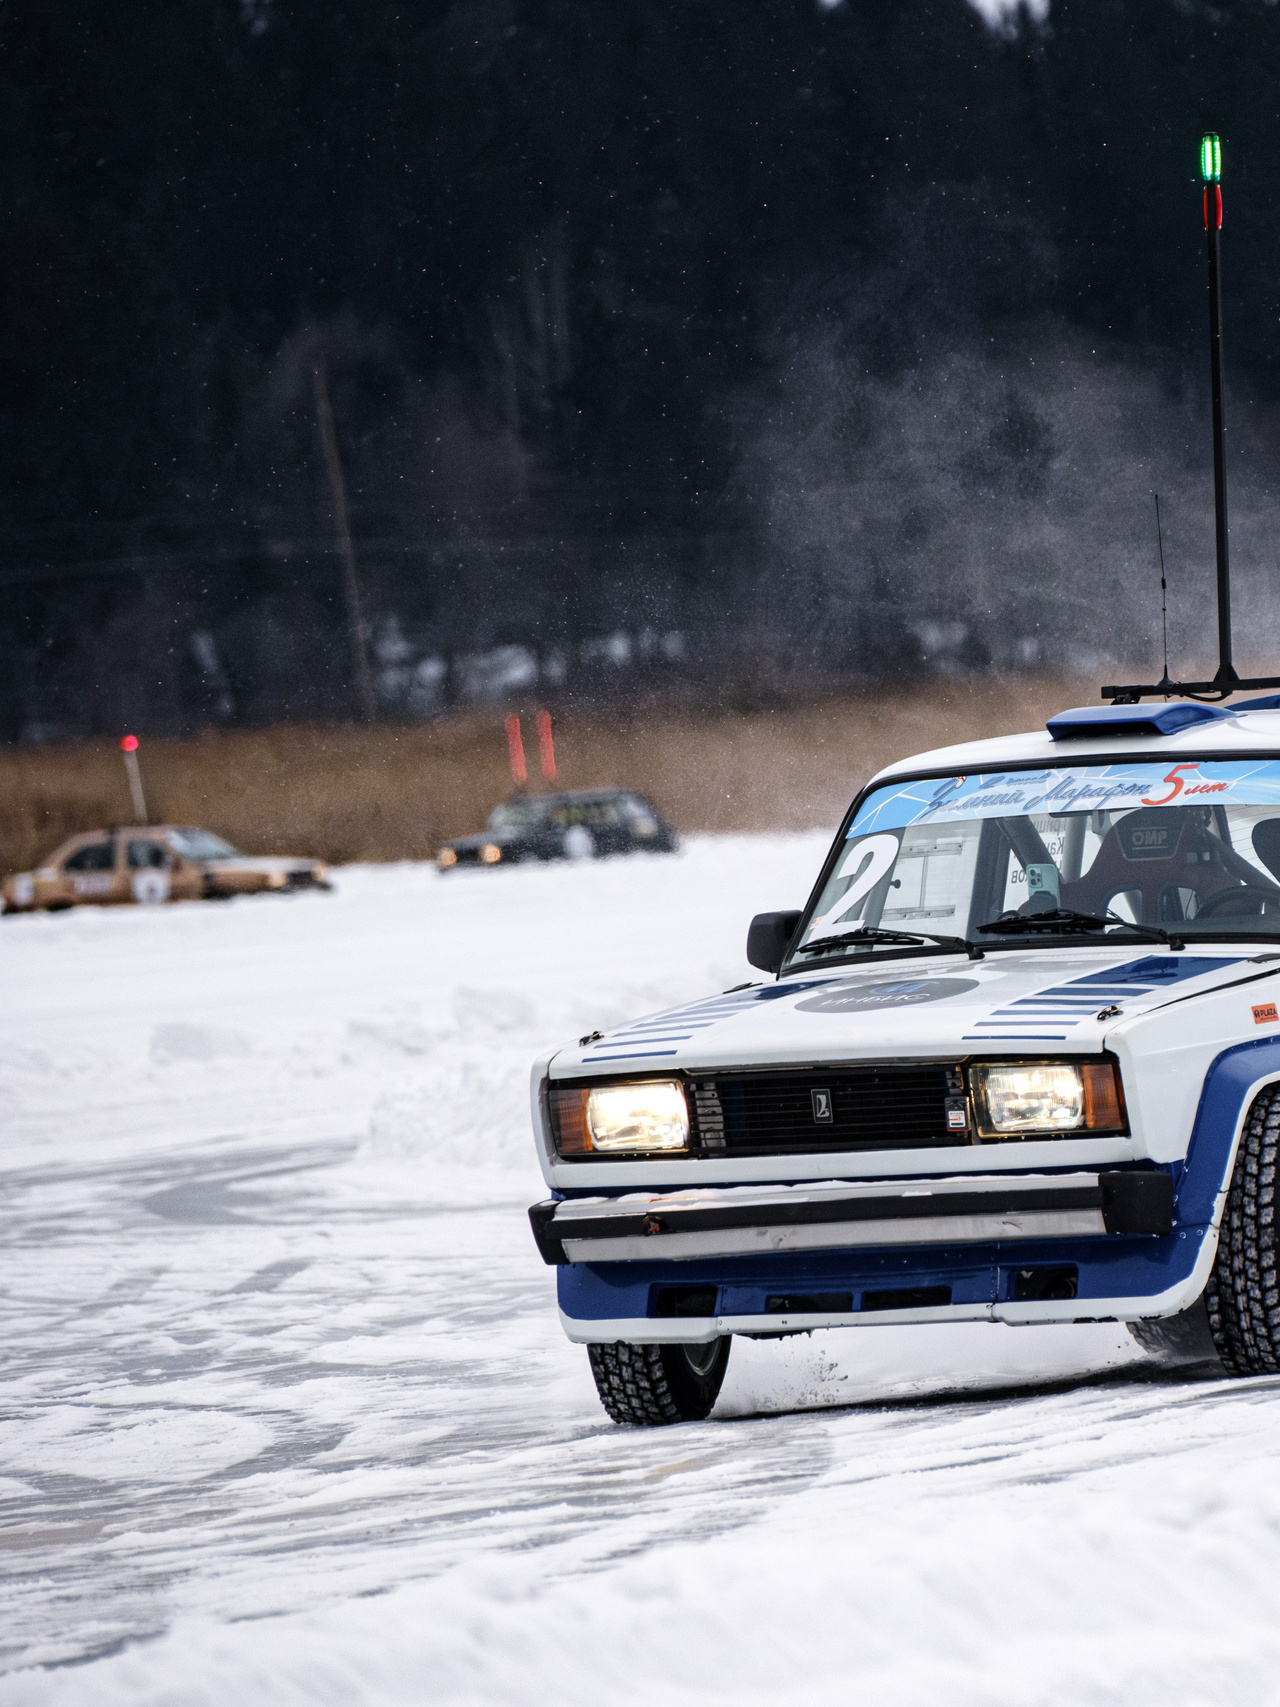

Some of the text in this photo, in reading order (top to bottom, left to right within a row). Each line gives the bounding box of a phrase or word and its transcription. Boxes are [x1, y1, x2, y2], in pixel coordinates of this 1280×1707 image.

[1023, 775, 1154, 811] Марафон
[1141, 763, 1200, 806] 5
[1184, 781, 1229, 796] лет
[1131, 831, 1168, 846] OMP
[807, 834, 899, 943] 2
[1259, 1007, 1277, 1017] PLAZA
